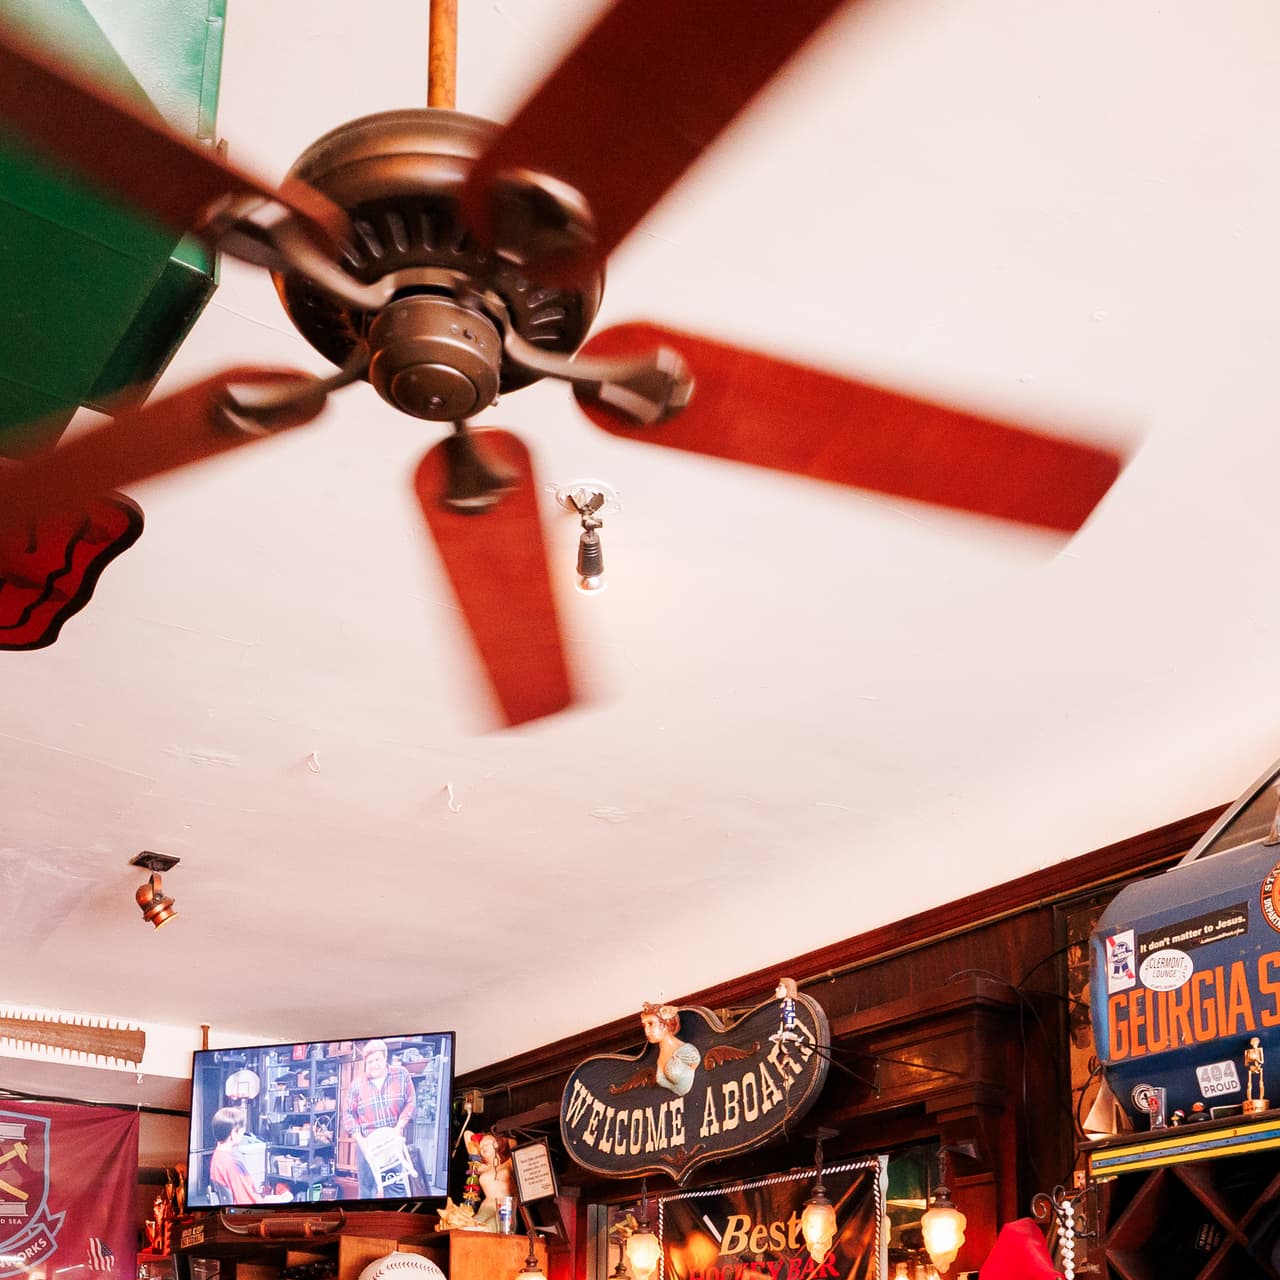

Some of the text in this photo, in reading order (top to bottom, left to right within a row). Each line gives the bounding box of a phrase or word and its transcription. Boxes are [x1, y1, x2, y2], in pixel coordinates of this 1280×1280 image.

[1140, 945, 1147, 953] It
[1149, 938, 1170, 951] don't
[1172, 929, 1202, 945] matter
[1204, 924, 1213, 934] to
[1216, 915, 1246, 930] Jesus.
[1149, 957, 1185, 969] CLERMONT
[1153, 969, 1177, 979] LOUNGE
[1109, 960, 1256, 1061] GEORGIA
[565, 1018, 816, 1156] WELCOME ABOARD
[1199, 1061, 1236, 1085] 404
[1204, 1080, 1238, 1095] PROUD
[719, 1210, 802, 1256] Best
